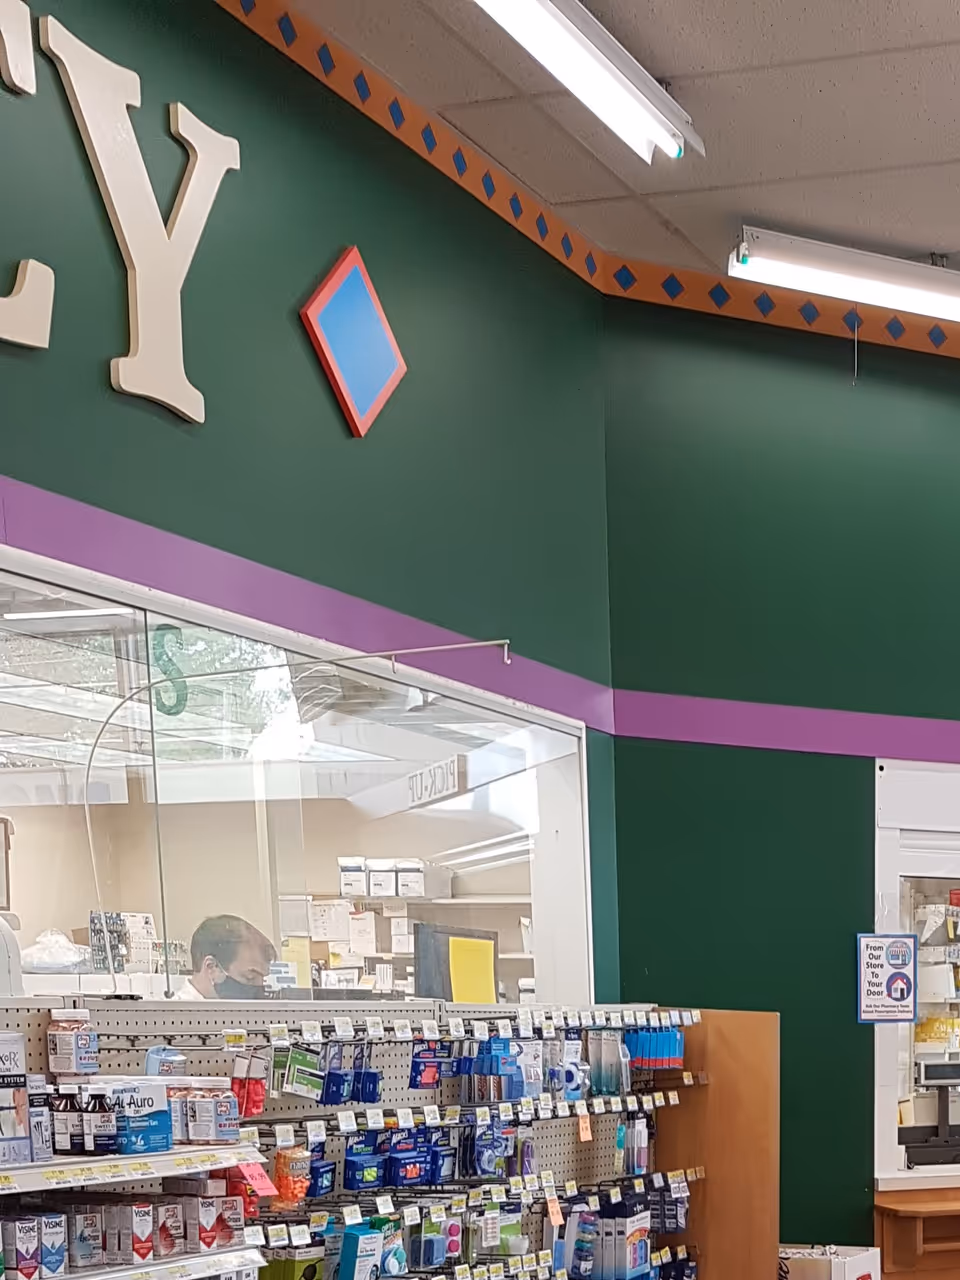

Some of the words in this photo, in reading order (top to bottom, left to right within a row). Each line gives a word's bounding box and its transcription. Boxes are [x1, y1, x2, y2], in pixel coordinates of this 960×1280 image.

[866, 944, 883, 952] From
[871, 971, 879, 979] To
[867, 980, 883, 988] Your
[128, 1096, 154, 1109] Auro
[44, 1219, 64, 1230] VISINE
[18, 1225, 36, 1234] VISINE
